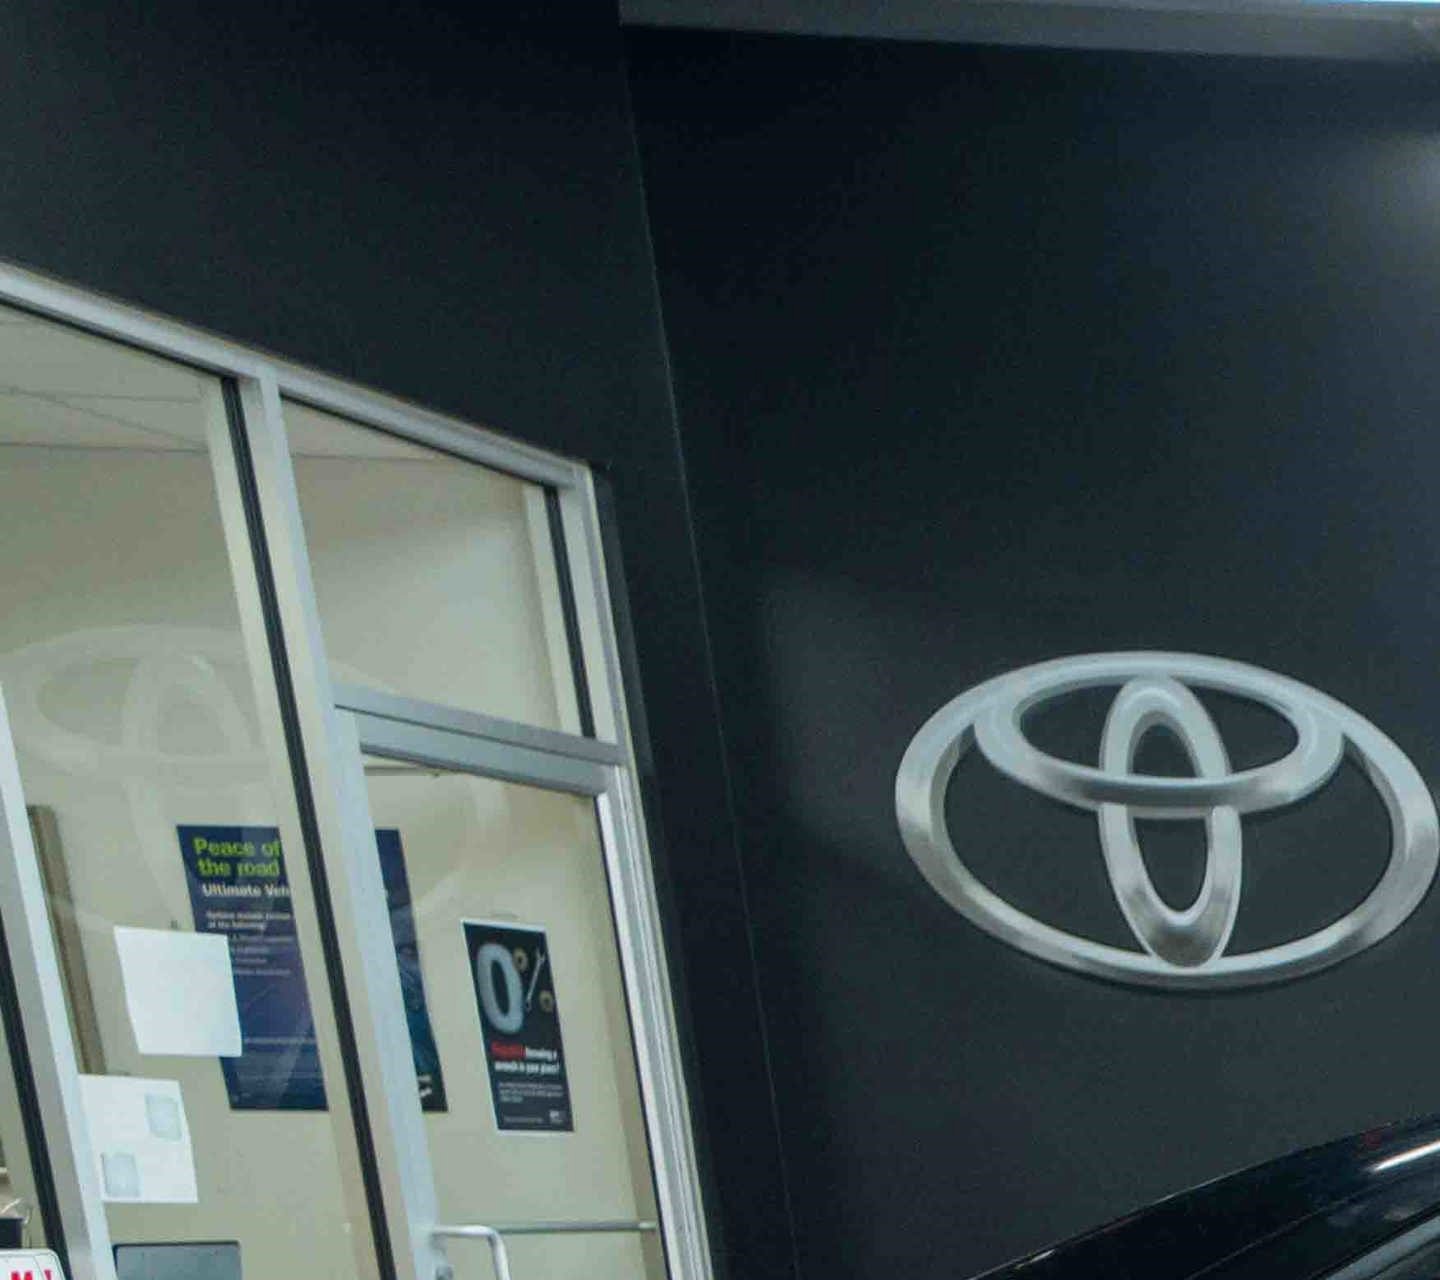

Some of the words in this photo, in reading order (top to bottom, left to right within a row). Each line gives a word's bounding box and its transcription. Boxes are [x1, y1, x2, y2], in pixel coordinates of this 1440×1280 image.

[193, 837, 254, 856] Peace
[261, 839, 280, 857] of
[197, 858, 230, 876] the
[237, 859, 280, 876] road
[202, 882, 262, 897] Ultimate
